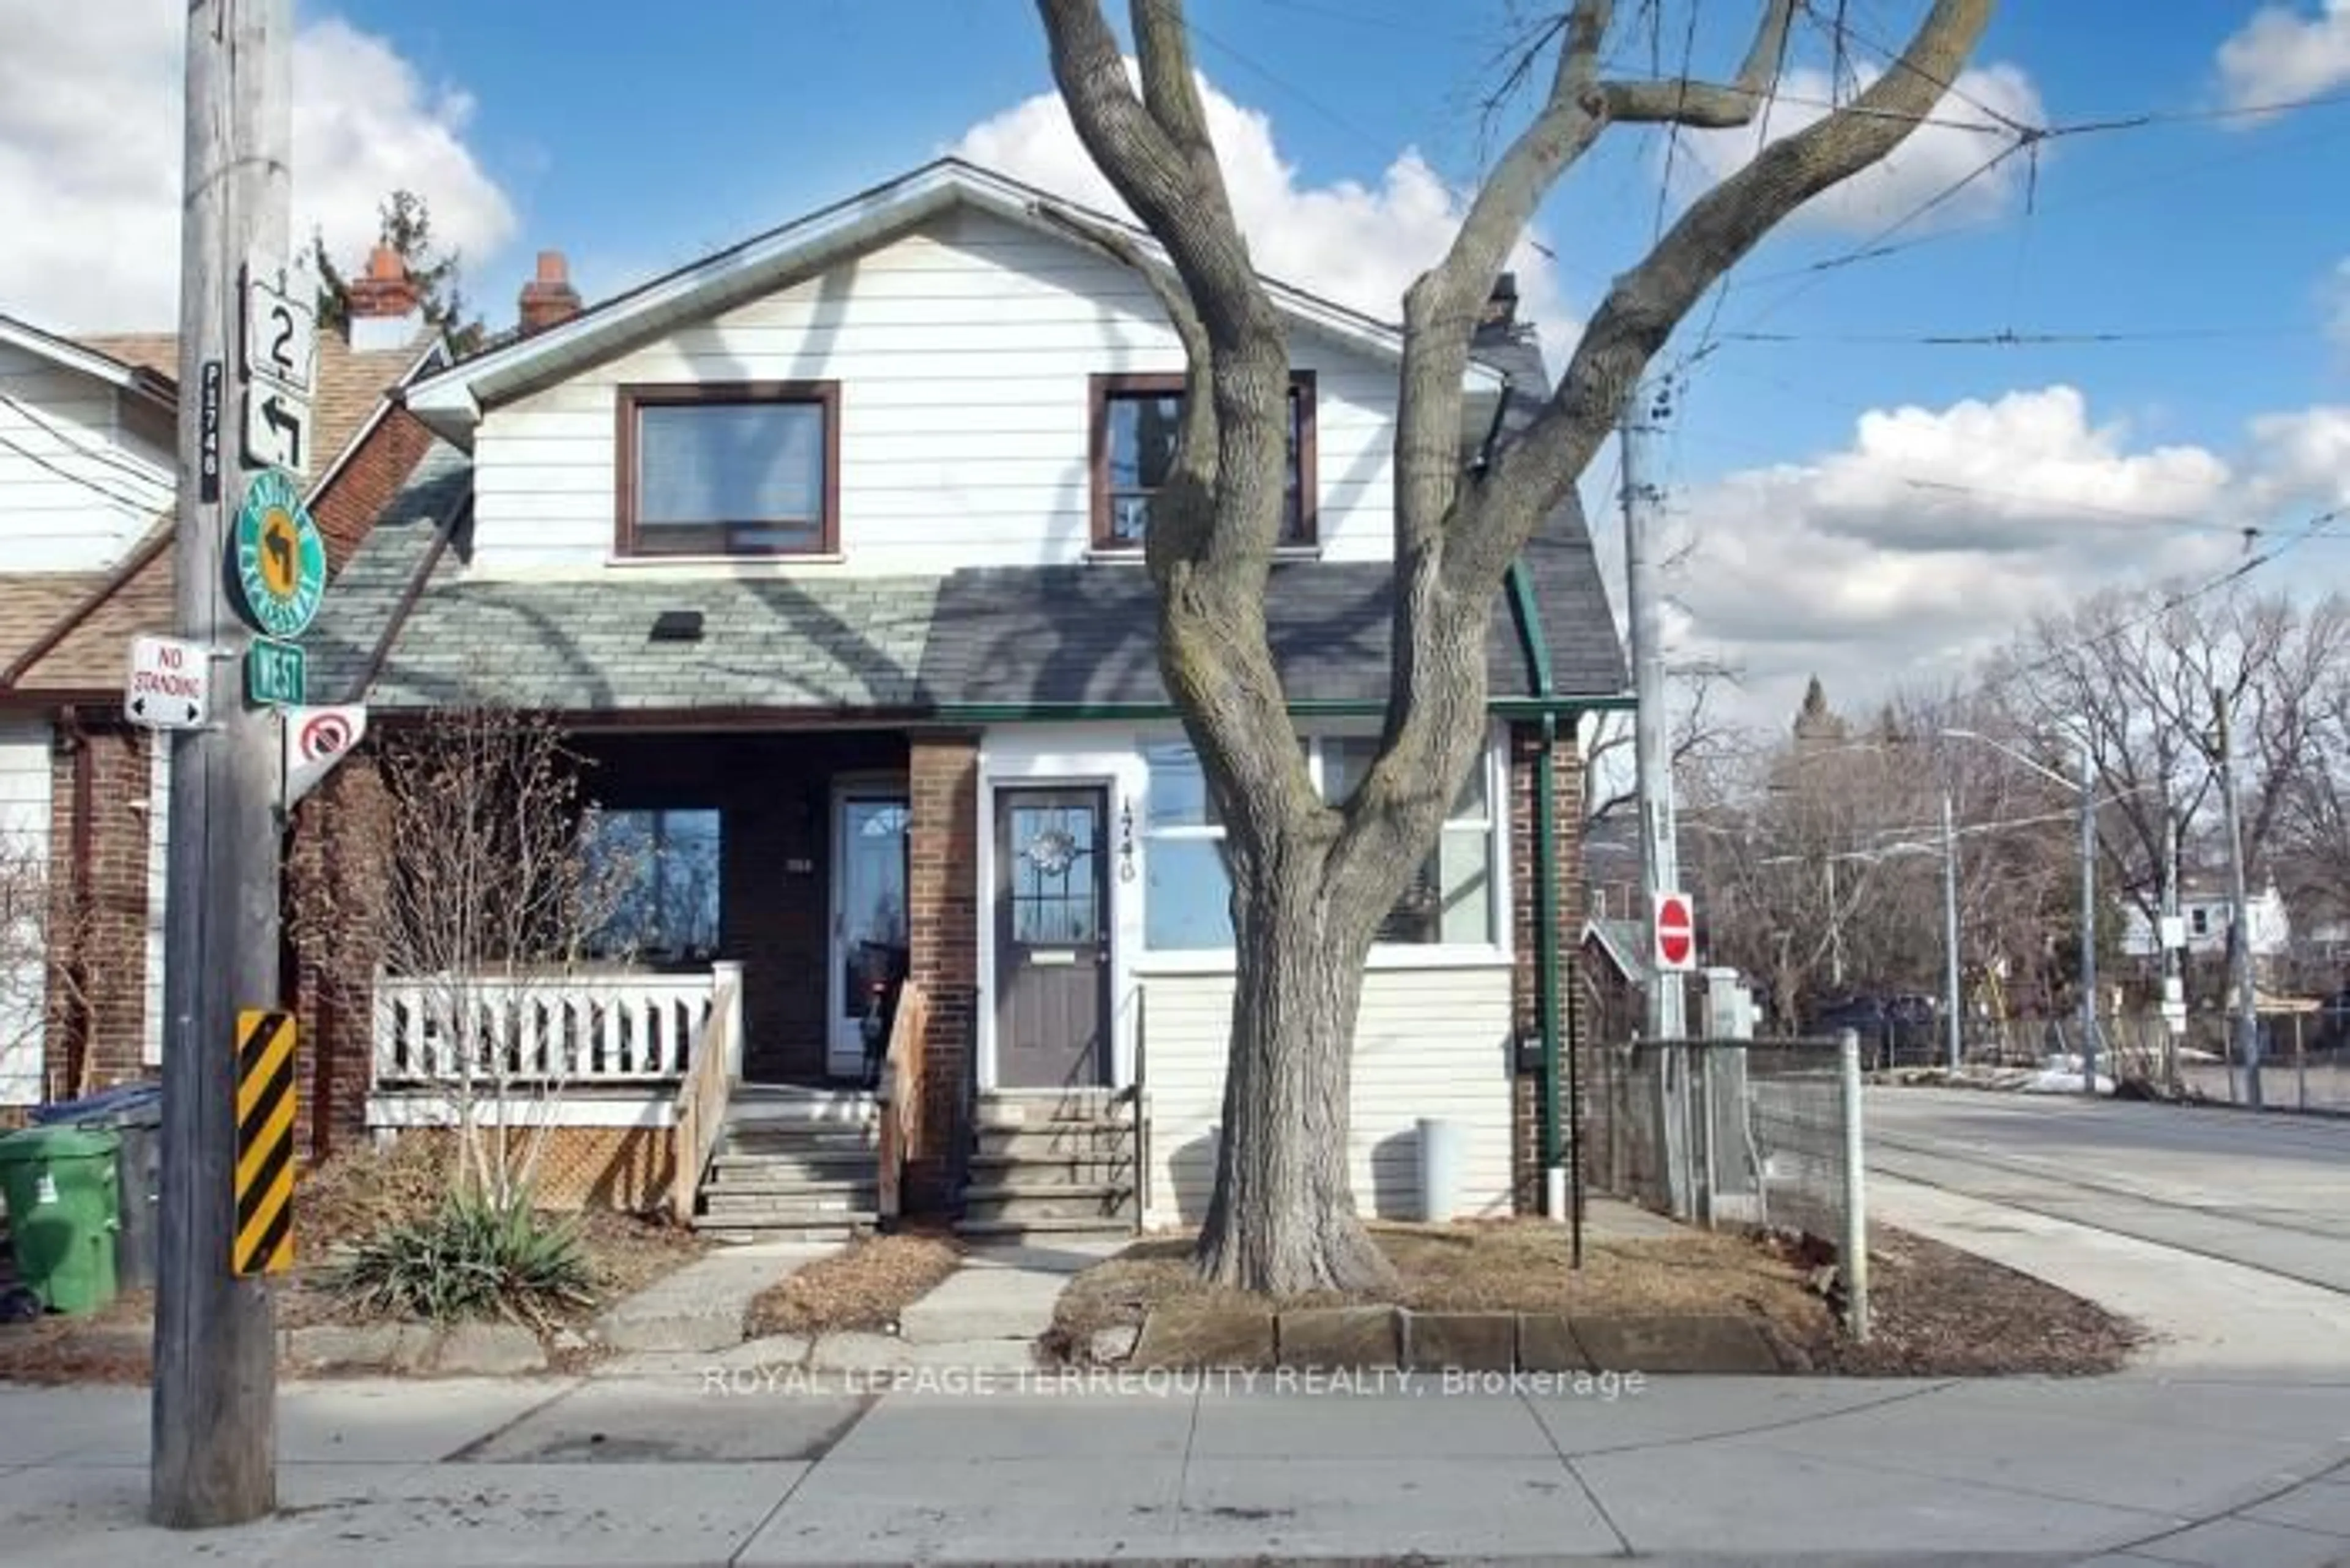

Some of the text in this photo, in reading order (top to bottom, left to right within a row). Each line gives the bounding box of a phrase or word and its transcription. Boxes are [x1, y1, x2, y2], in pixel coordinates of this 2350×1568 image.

[272, 305, 293, 368] 2
[159, 648, 182, 669] NO
[257, 647, 299, 699] WEST
